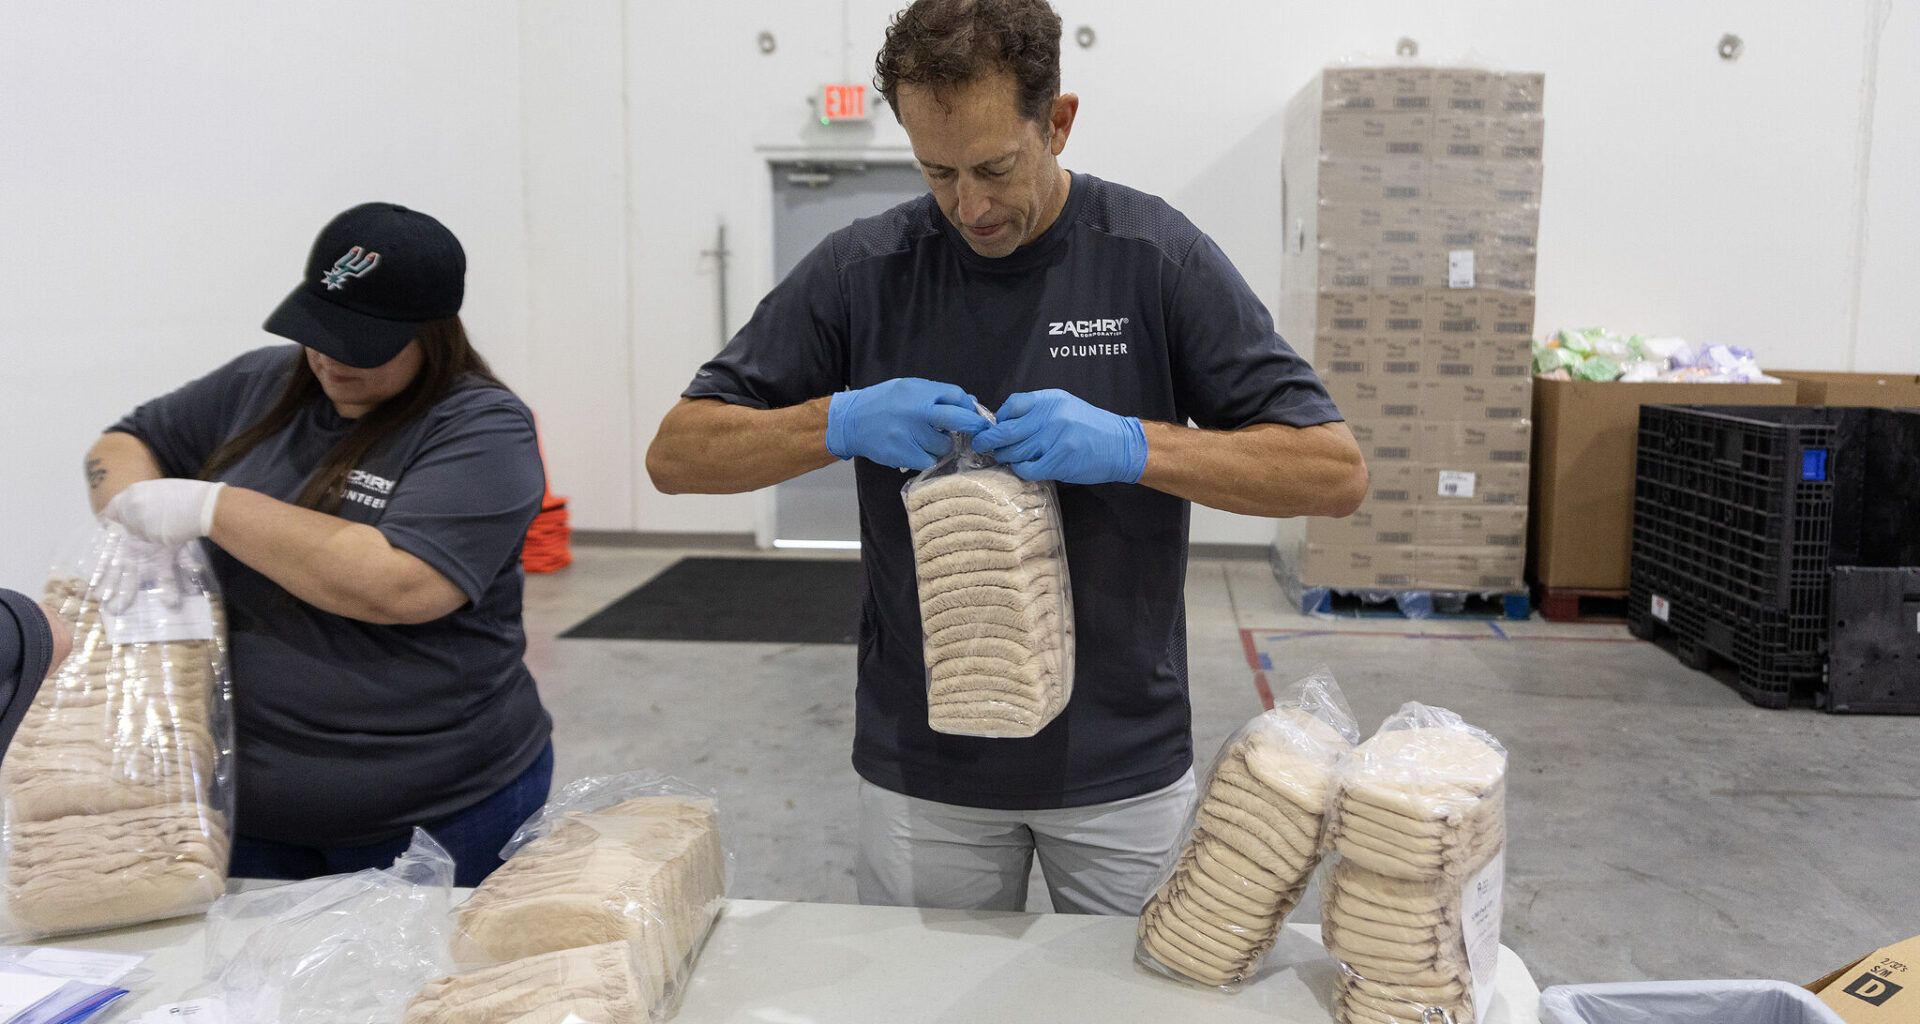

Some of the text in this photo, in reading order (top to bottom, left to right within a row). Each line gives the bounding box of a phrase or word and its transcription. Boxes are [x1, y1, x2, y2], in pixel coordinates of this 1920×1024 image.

[825, 85, 866, 118] EXIT
[1049, 343, 1128, 358] VOLUNTEER
[347, 470, 396, 490] CHRY
[1870, 965, 1892, 978] S/M
[1855, 978, 1886, 998] D
